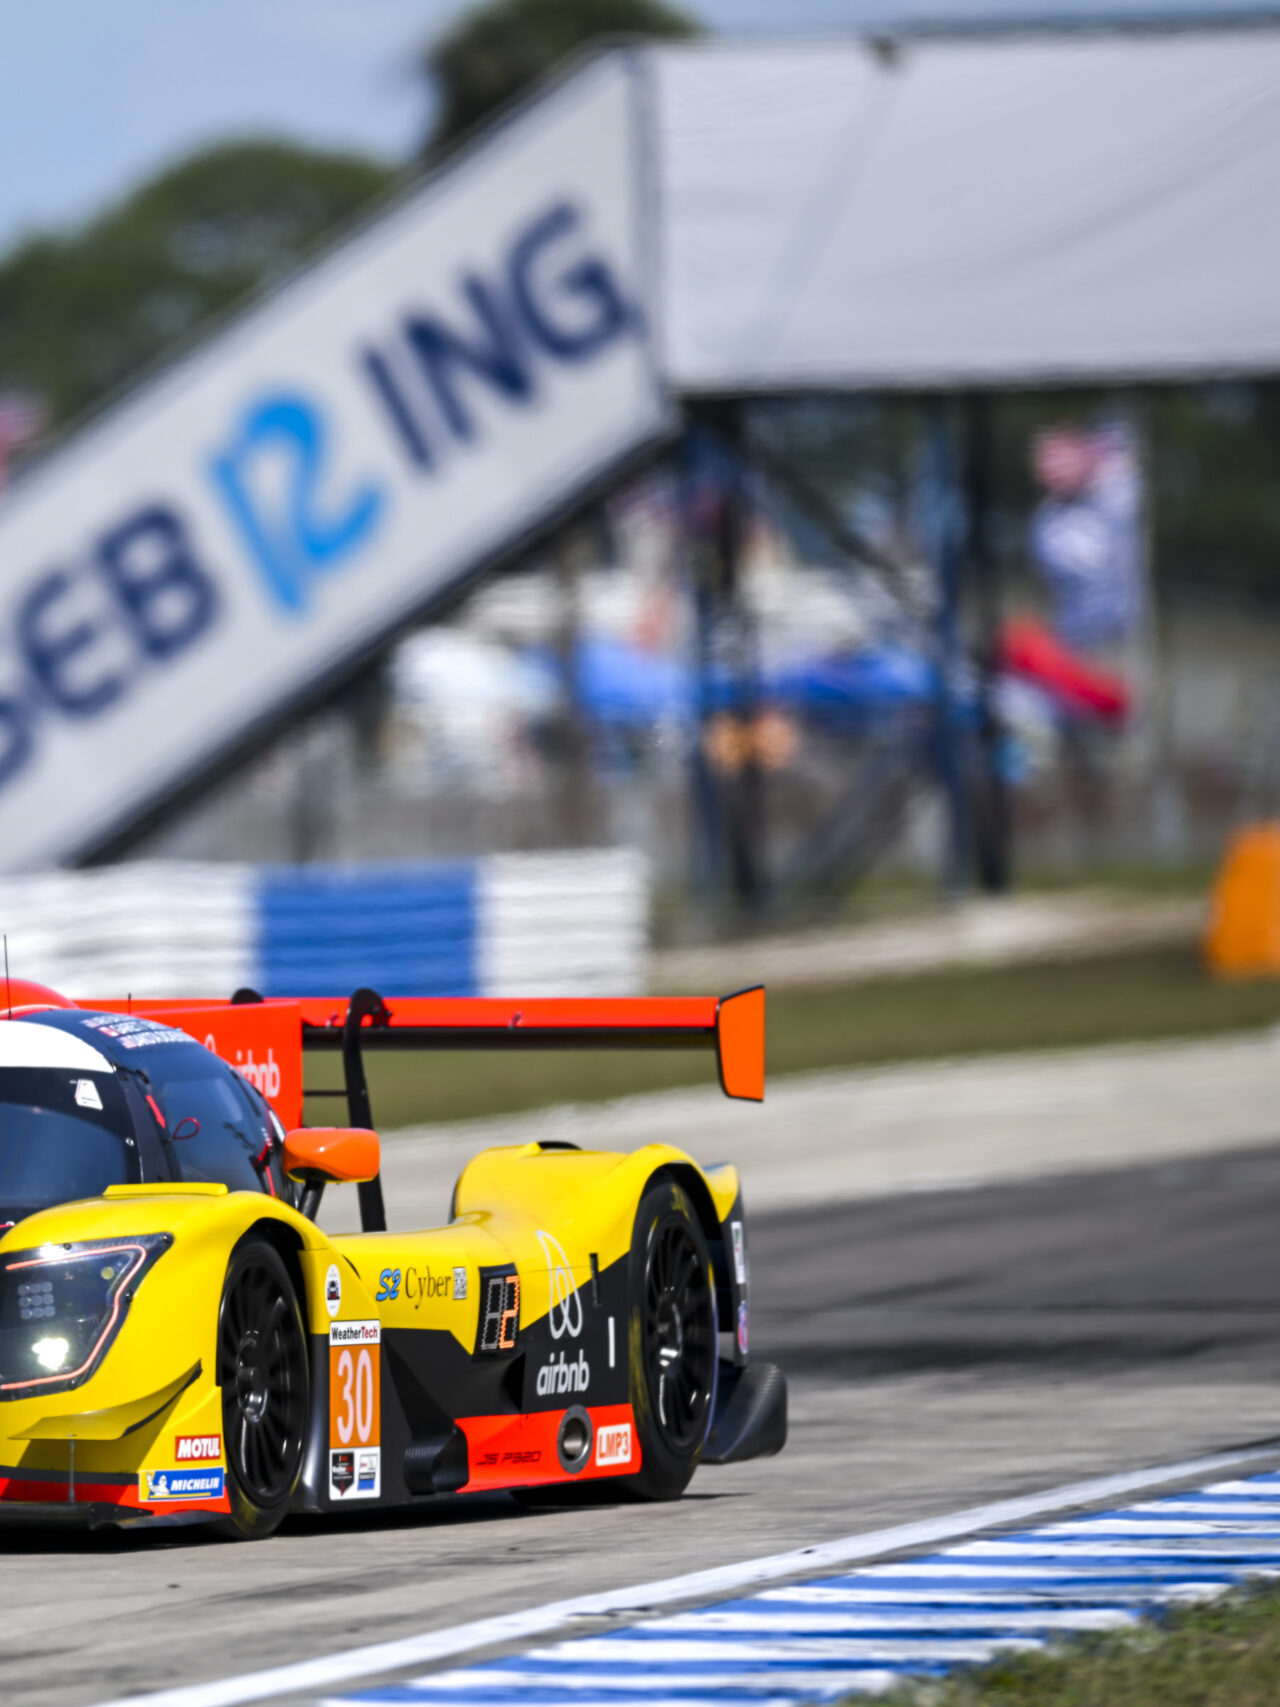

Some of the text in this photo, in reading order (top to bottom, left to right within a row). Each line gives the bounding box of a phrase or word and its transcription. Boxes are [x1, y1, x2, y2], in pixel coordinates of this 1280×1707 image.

[376, 1268, 401, 1301] S2
[405, 1265, 451, 1310] Cyber
[331, 1326, 378, 1341] WeatherTech
[536, 1348, 590, 1396] airbnb
[337, 1349, 373, 1444] 30
[177, 1437, 220, 1458] MOTUL
[598, 1431, 629, 1459] LMP3
[170, 1477, 220, 1491] MICHELIN
